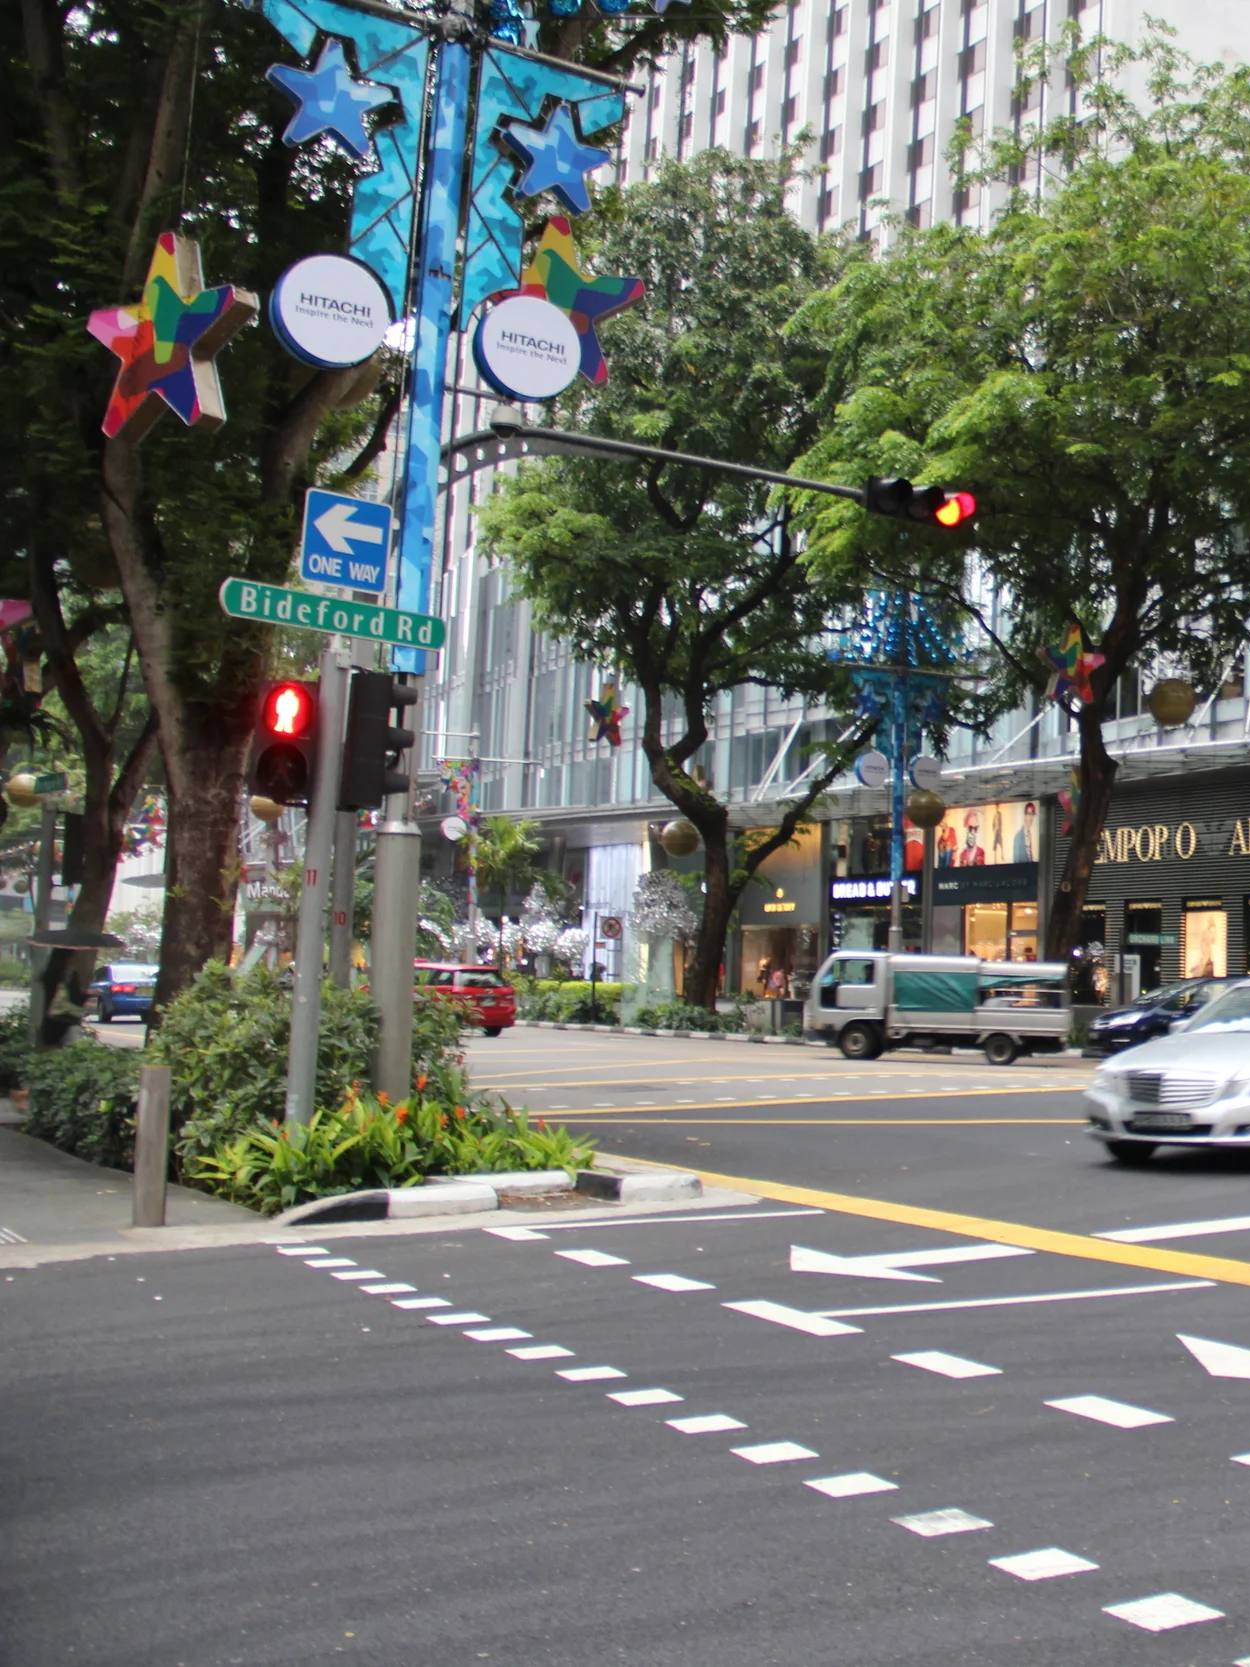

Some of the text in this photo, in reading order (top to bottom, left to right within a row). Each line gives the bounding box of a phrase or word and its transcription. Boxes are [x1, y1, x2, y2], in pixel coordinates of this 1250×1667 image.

[295, 304, 374, 329] Inspire the Next
[300, 293, 371, 318] HITACHI
[496, 340, 568, 366] Inspire the Next
[501, 330, 565, 355] HITACHI
[308, 553, 381, 584] ONE WAY
[239, 585, 433, 645] Bideford Rd
[306, 870, 318, 887] 11
[333, 910, 347, 926] 10
